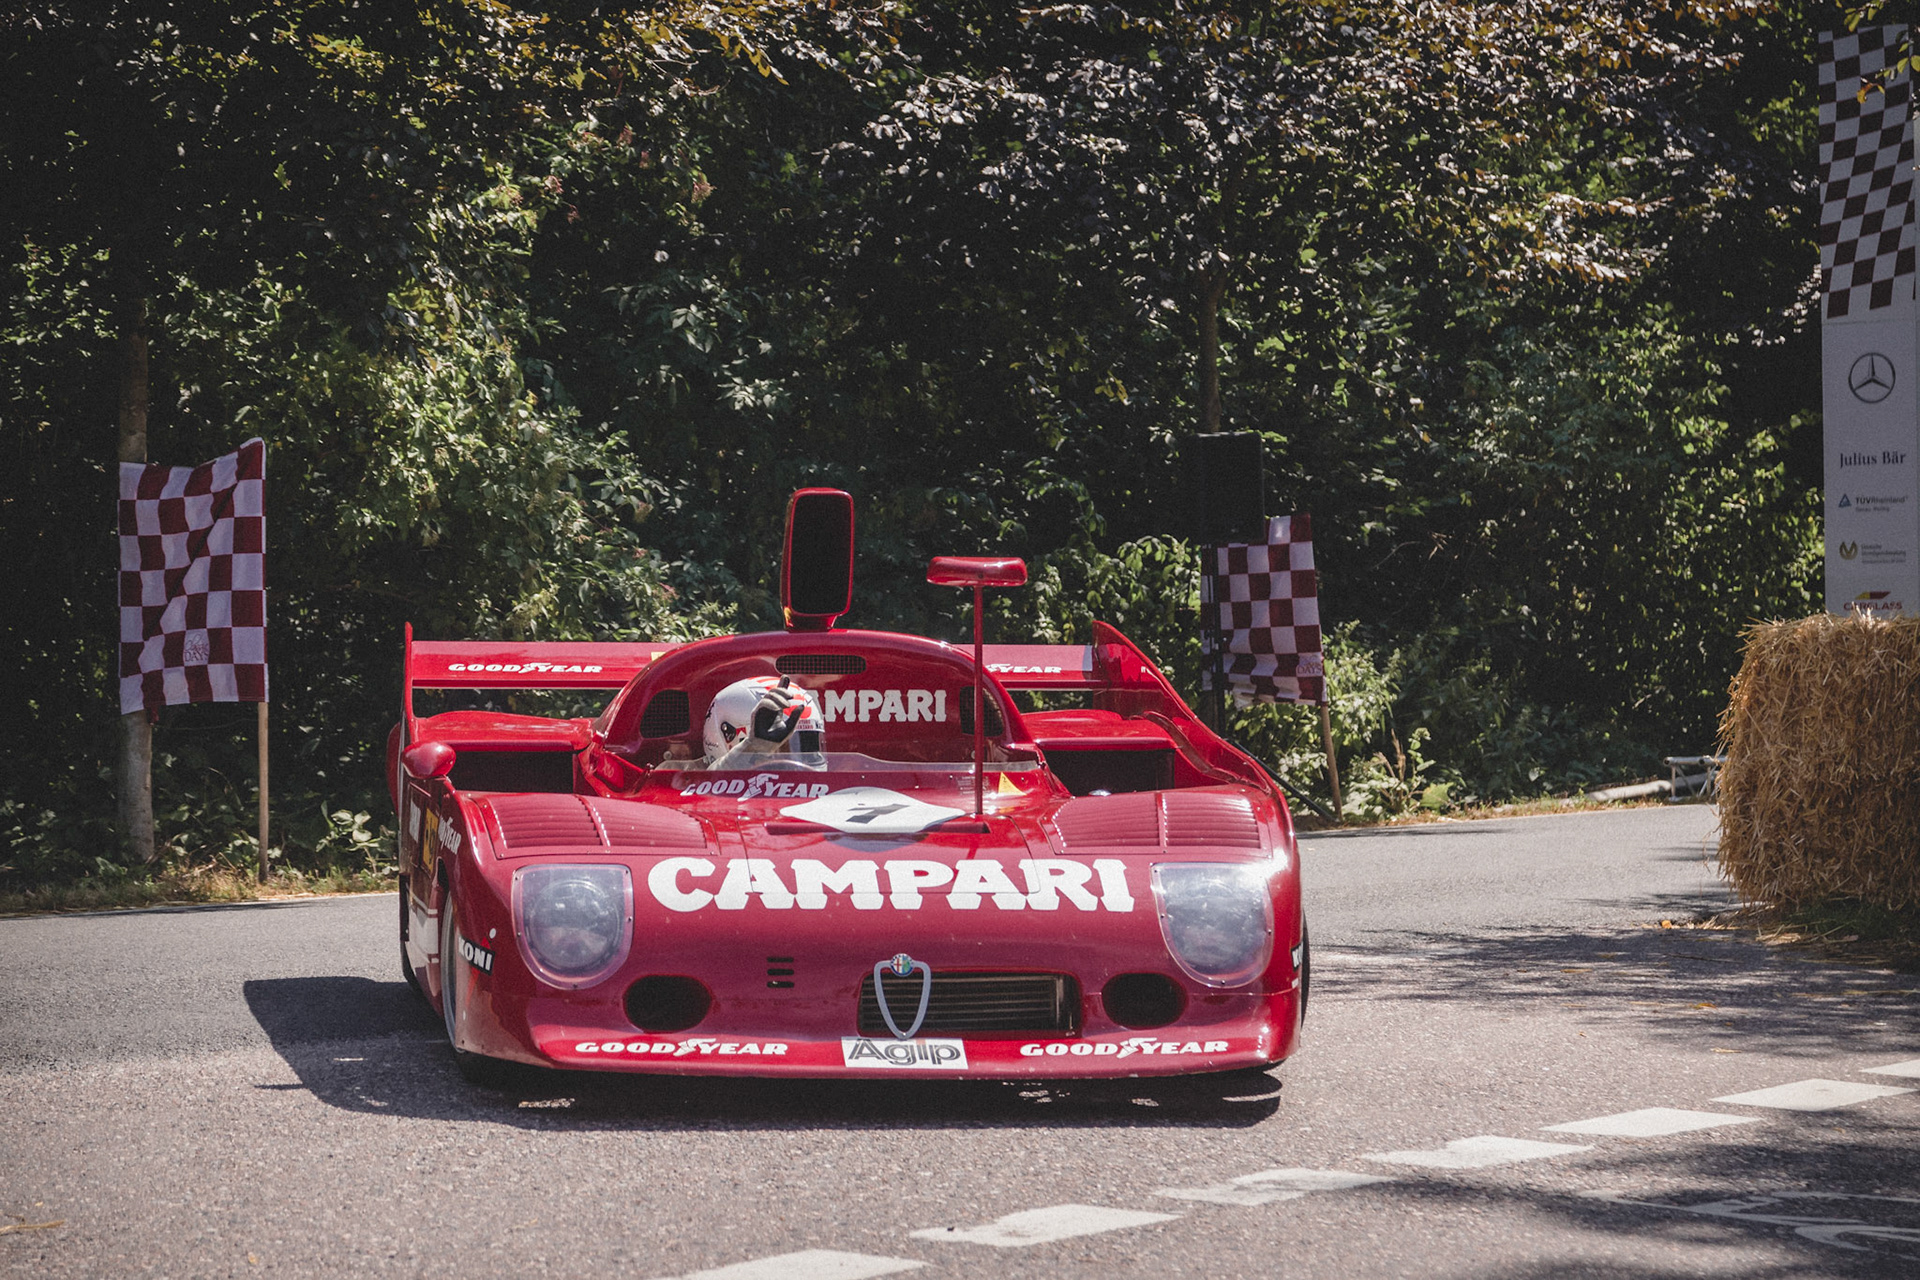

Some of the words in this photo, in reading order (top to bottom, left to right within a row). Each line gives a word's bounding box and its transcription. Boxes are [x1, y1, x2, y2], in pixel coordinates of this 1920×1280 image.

[1840, 452, 1877, 469] Julius
[1882, 451, 1906, 465] Bär
[448, 662, 602, 673] GOODYEAR
[985, 663, 1062, 673] YEAR
[680, 773, 829, 802] GOODYEAR
[846, 803, 910, 824] 7
[647, 857, 1134, 912] CAMPARI
[458, 936, 492, 971] KONI
[575, 1038, 788, 1056] GOODYEAR
[848, 1038, 961, 1066] Agip
[1020, 1037, 1228, 1059] GOODYEAR
